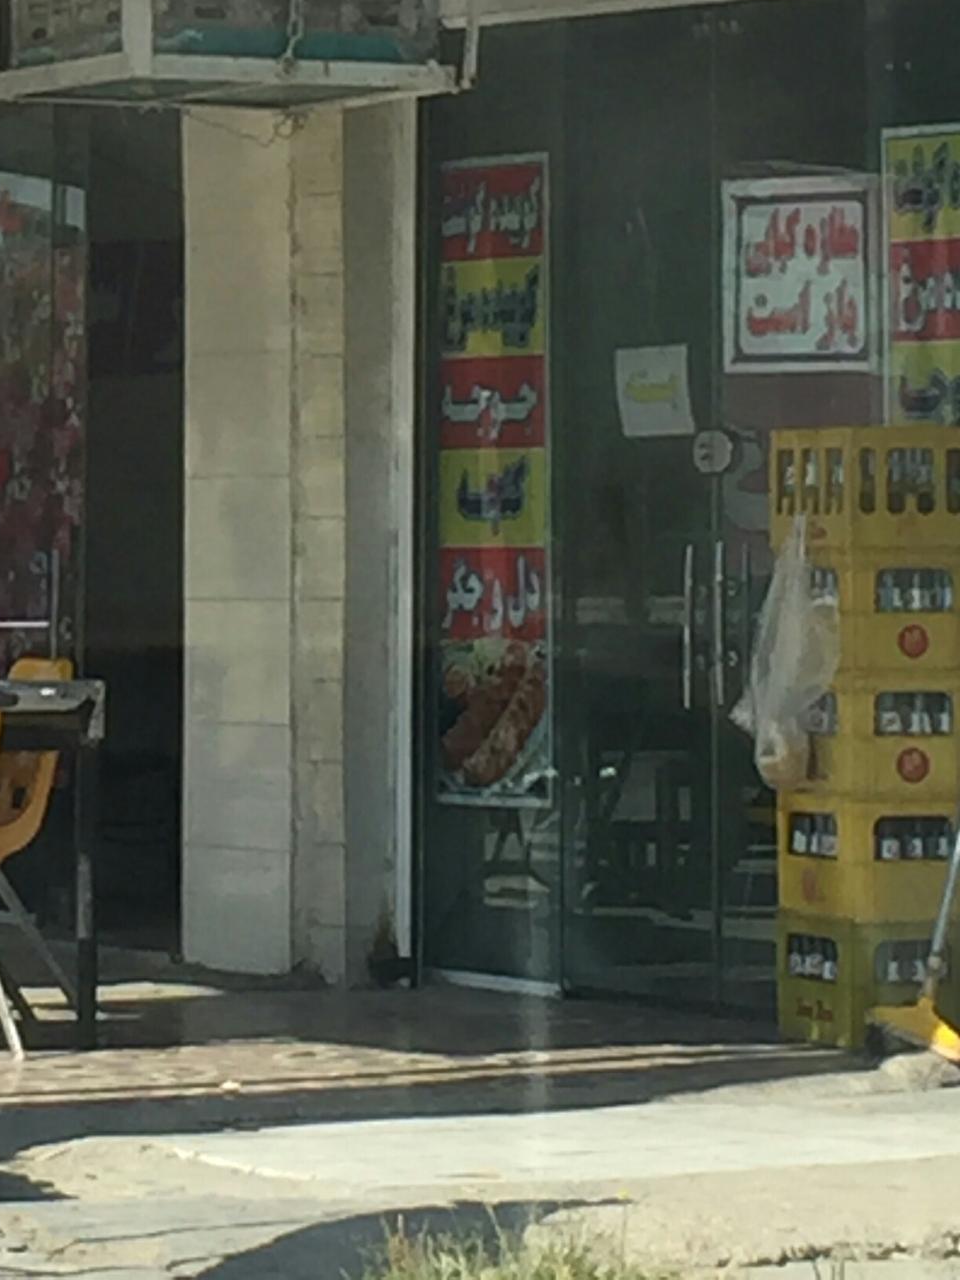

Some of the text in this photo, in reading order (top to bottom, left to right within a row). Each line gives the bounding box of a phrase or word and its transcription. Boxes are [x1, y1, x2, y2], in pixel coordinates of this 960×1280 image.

[746, 278, 858, 351] باز است
[441, 558, 484, 629] جگر
